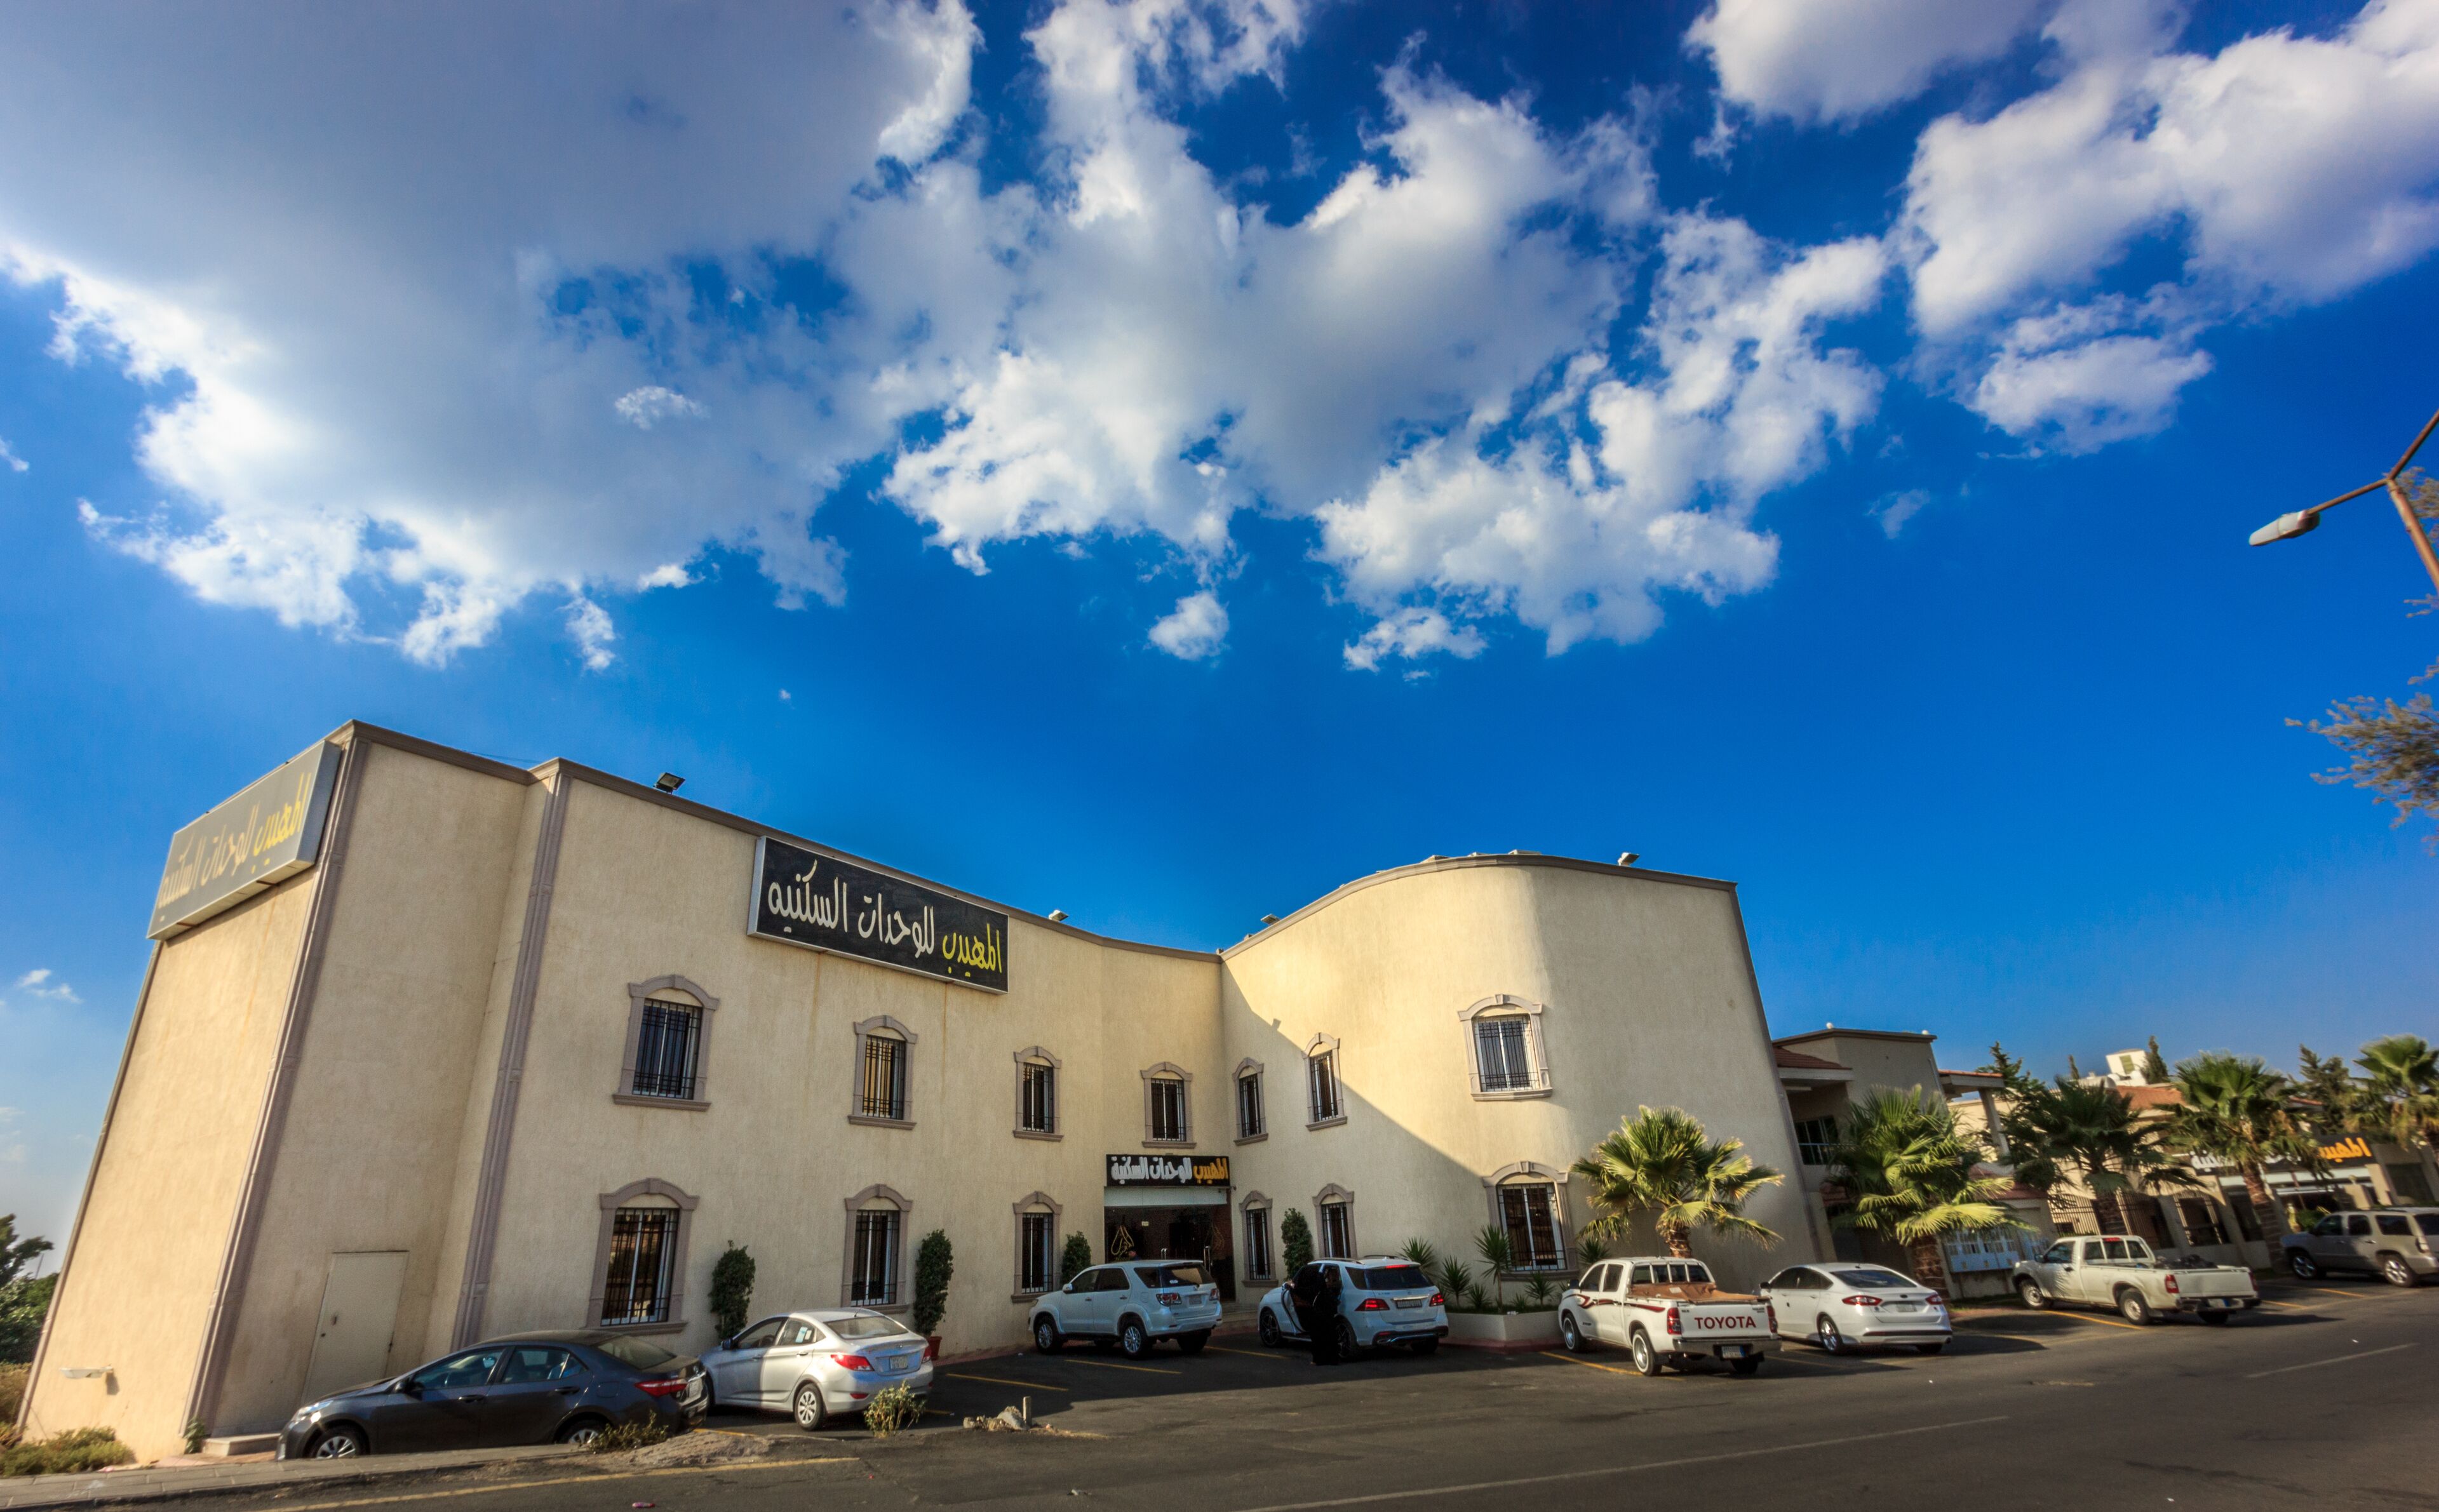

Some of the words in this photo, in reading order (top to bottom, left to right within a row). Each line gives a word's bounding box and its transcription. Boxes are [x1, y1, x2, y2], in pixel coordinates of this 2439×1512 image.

[857, 892, 936, 959] للوحدات
[941, 923, 1003, 977] المهيدب
[1111, 1156, 1150, 1184] السكنية
[1149, 1156, 1193, 1184] للوحدات
[1193, 1158, 1229, 1184] المهيدب
[1694, 1316, 1756, 1330] TOYOTA
